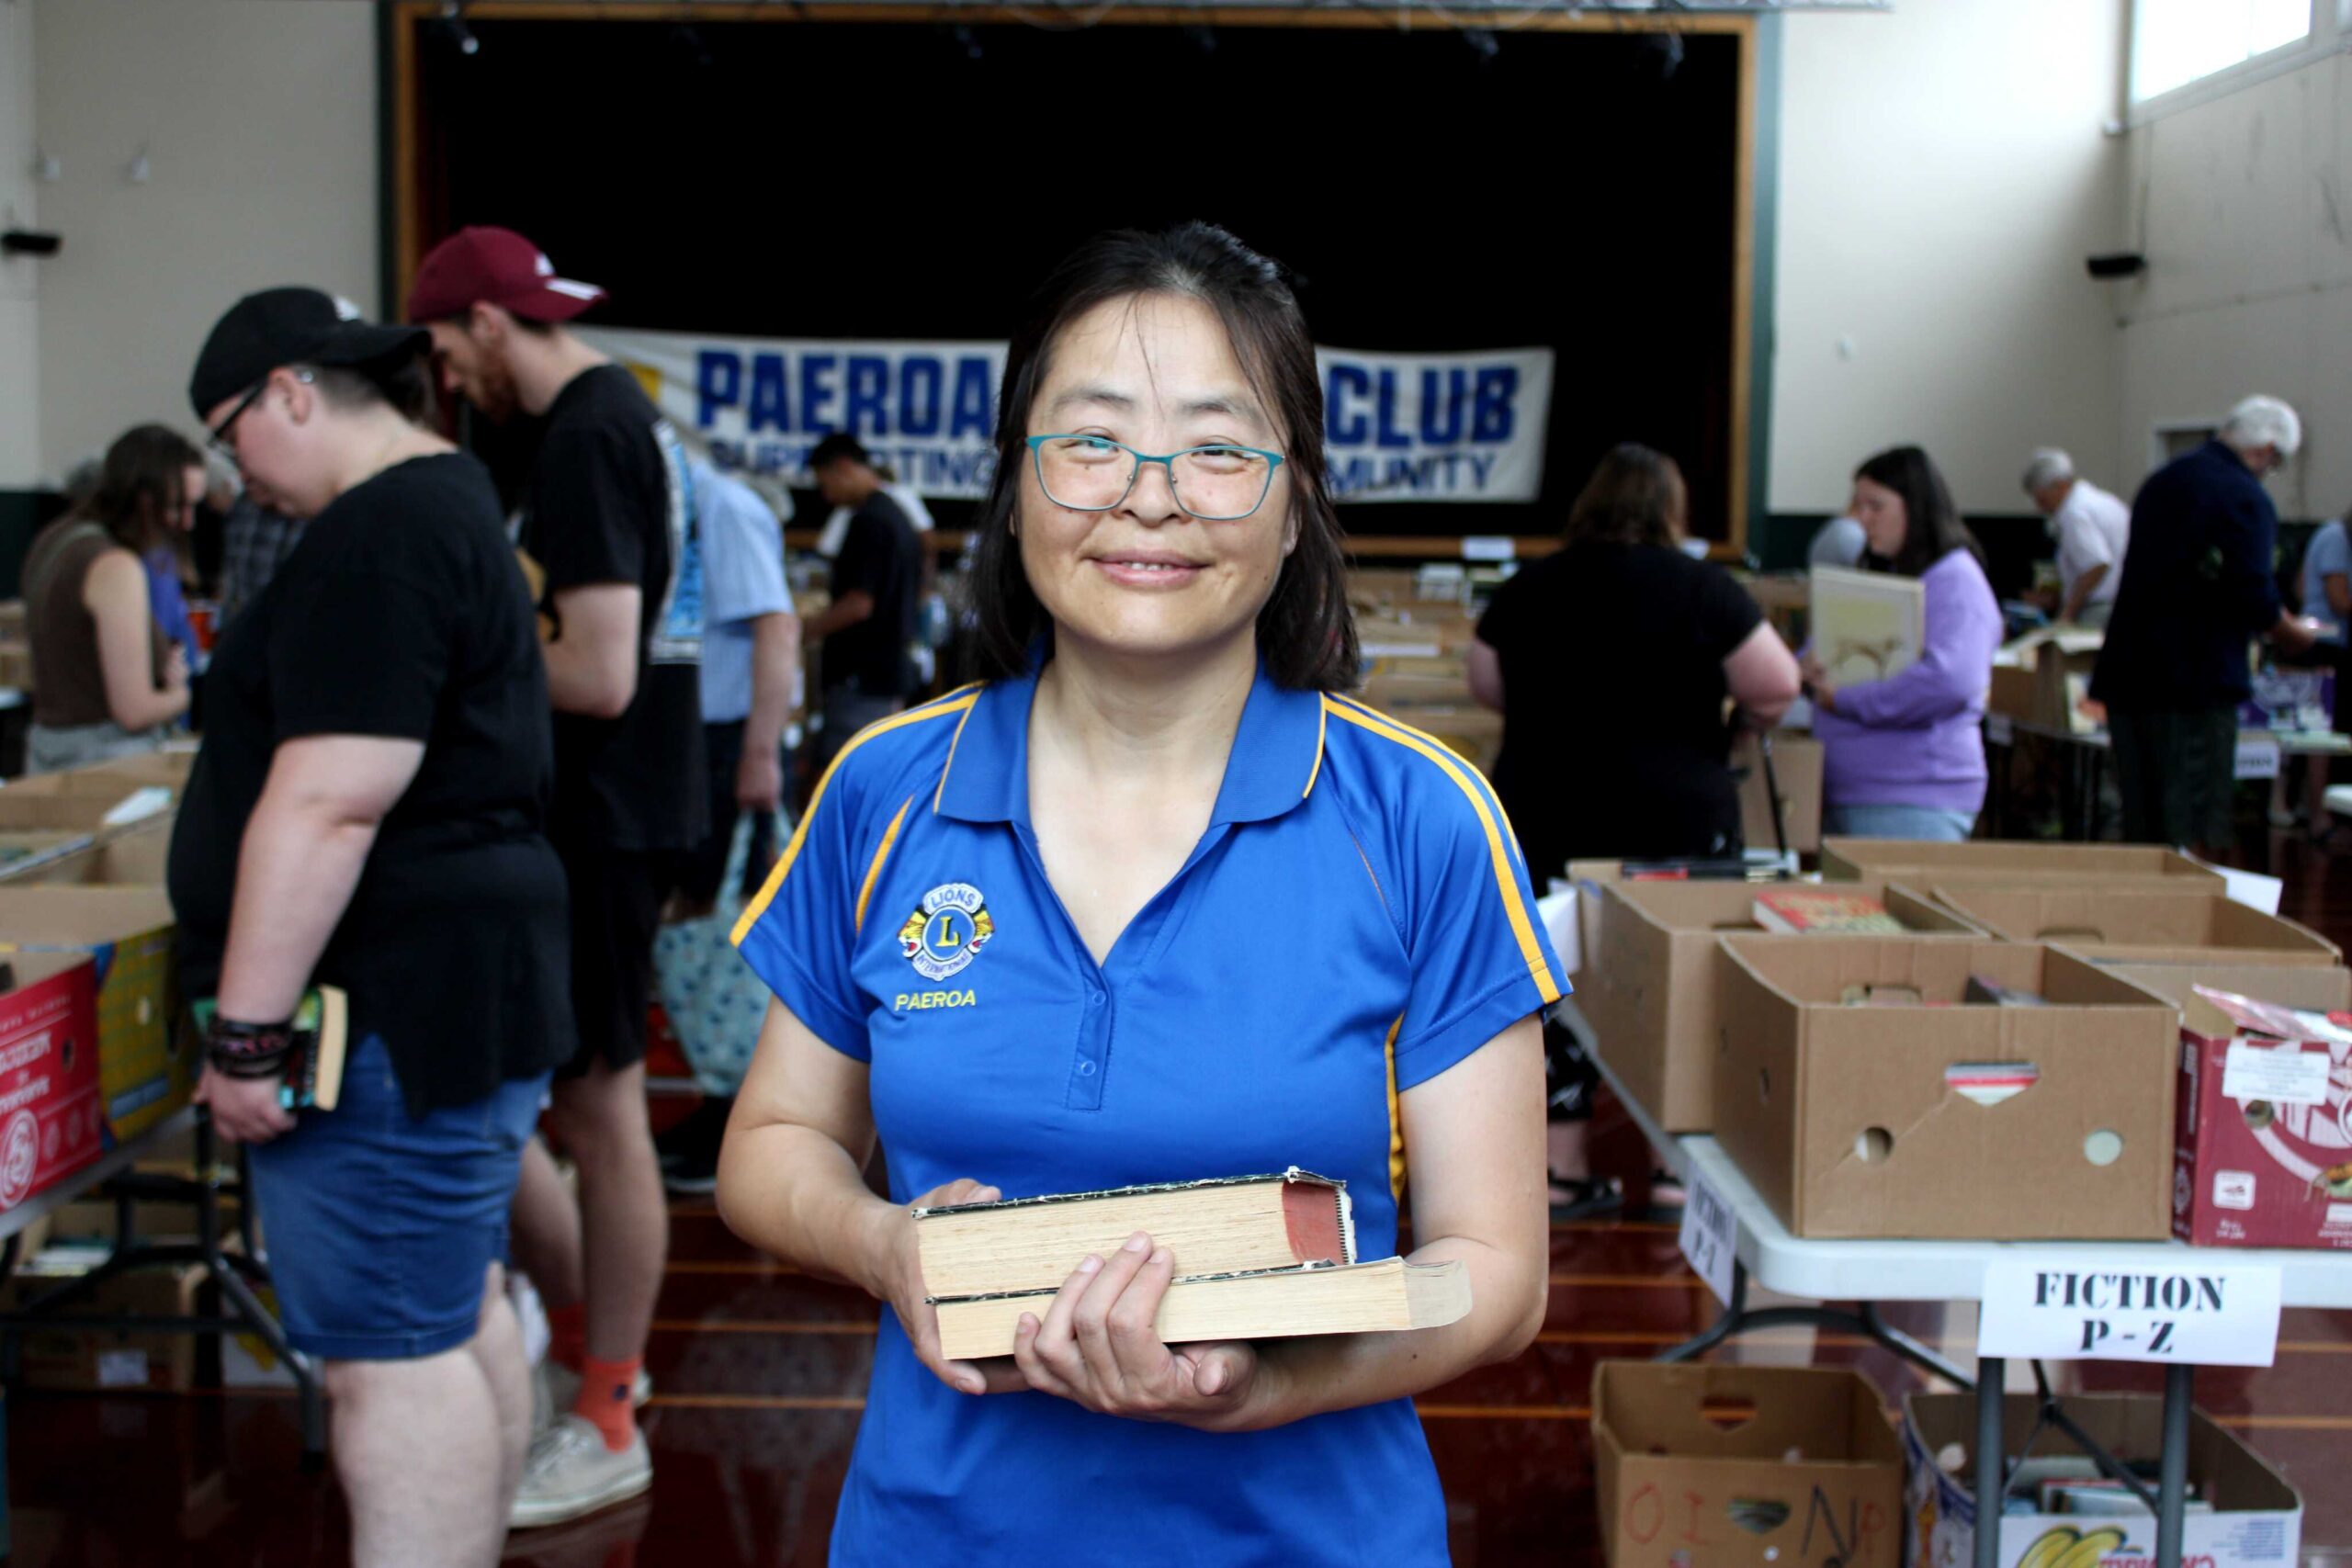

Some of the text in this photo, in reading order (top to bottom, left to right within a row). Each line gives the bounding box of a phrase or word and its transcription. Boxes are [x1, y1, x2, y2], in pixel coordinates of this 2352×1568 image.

[697, 349, 1519, 446] PAEROA CLUB
[1324, 453, 1496, 494] MUNITY
[931, 889, 977, 908] LIONS
[935, 916, 960, 947] L
[894, 989, 977, 1011] PAEROA
[2034, 1273, 2226, 1312] FICTION
